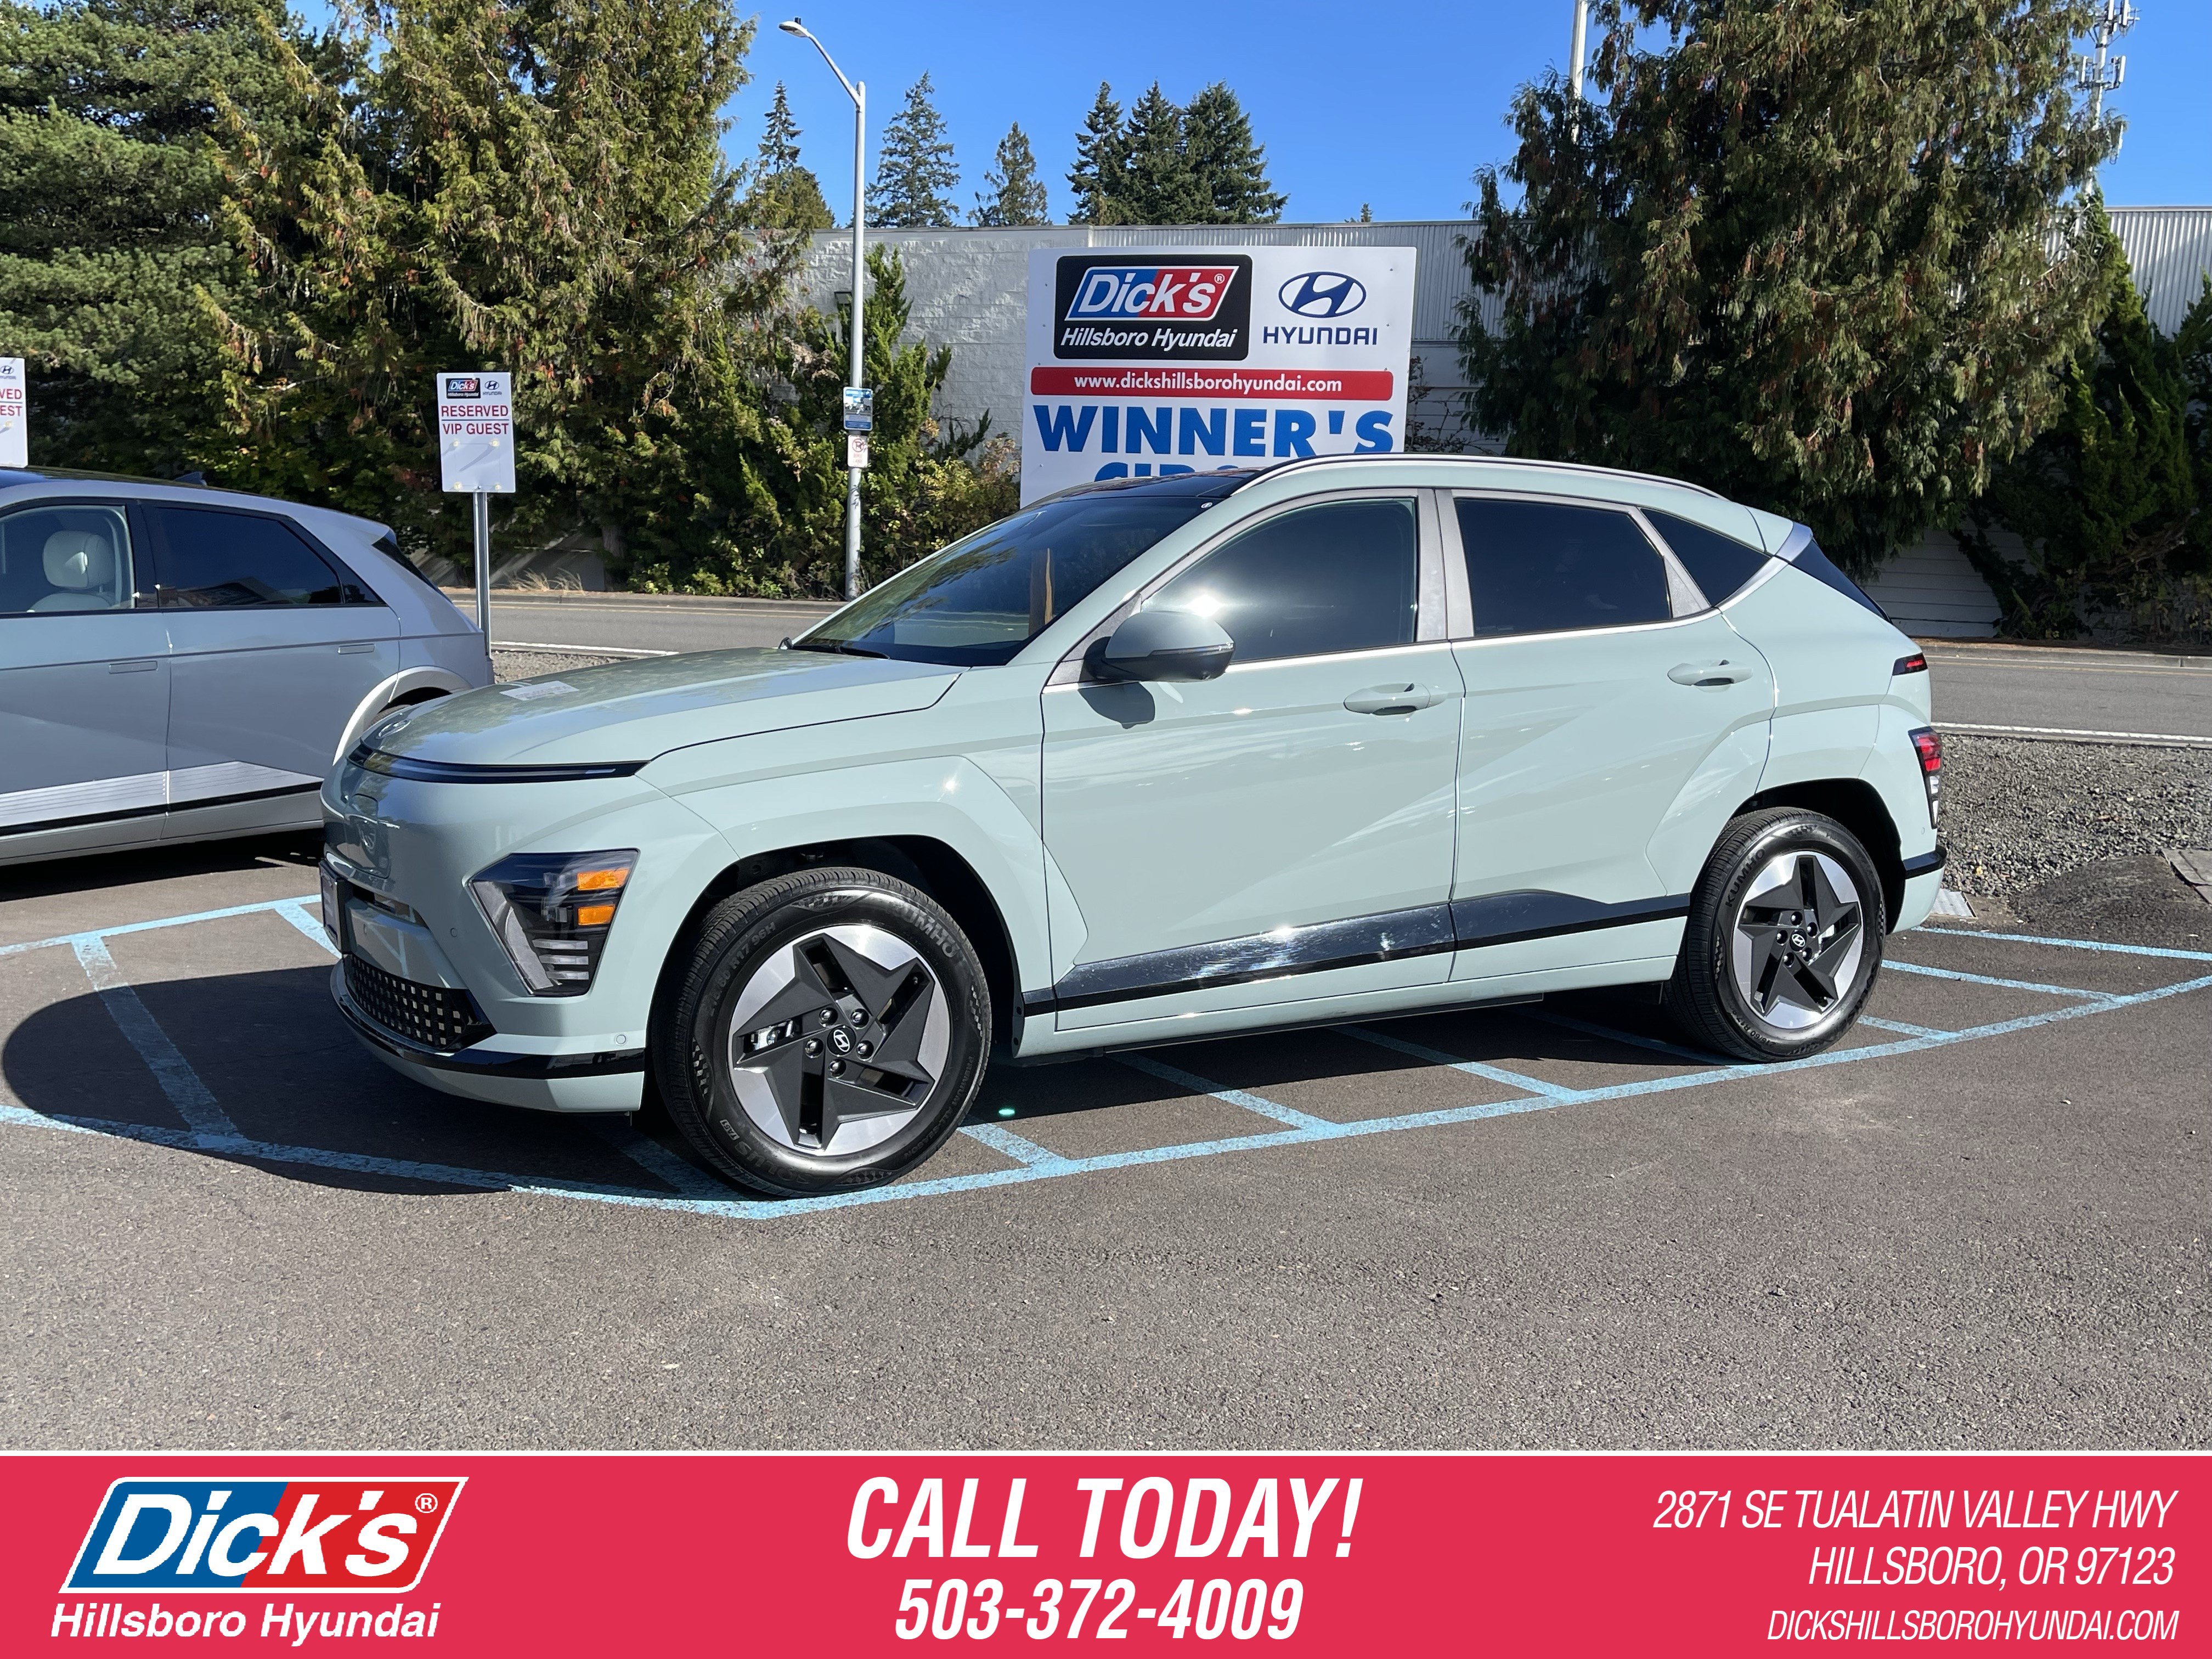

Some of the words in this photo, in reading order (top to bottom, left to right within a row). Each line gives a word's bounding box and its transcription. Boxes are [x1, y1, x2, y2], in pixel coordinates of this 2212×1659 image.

[1060, 328, 1148, 347] Hillsboro
[1151, 328, 1238, 352] Hyundai
[1263, 326, 1378, 346] HYUNDAI
[1074, 370, 1342, 395] www.dickshillsborohyundai.com
[441, 405, 509, 417] RESERVED
[442, 423, 462, 435] VIP
[466, 422, 509, 435] GUEST
[1033, 404, 1394, 458] WINNER'S
[1725, 849, 1765, 908] KUMHO
[893, 902, 960, 958] UMHO
